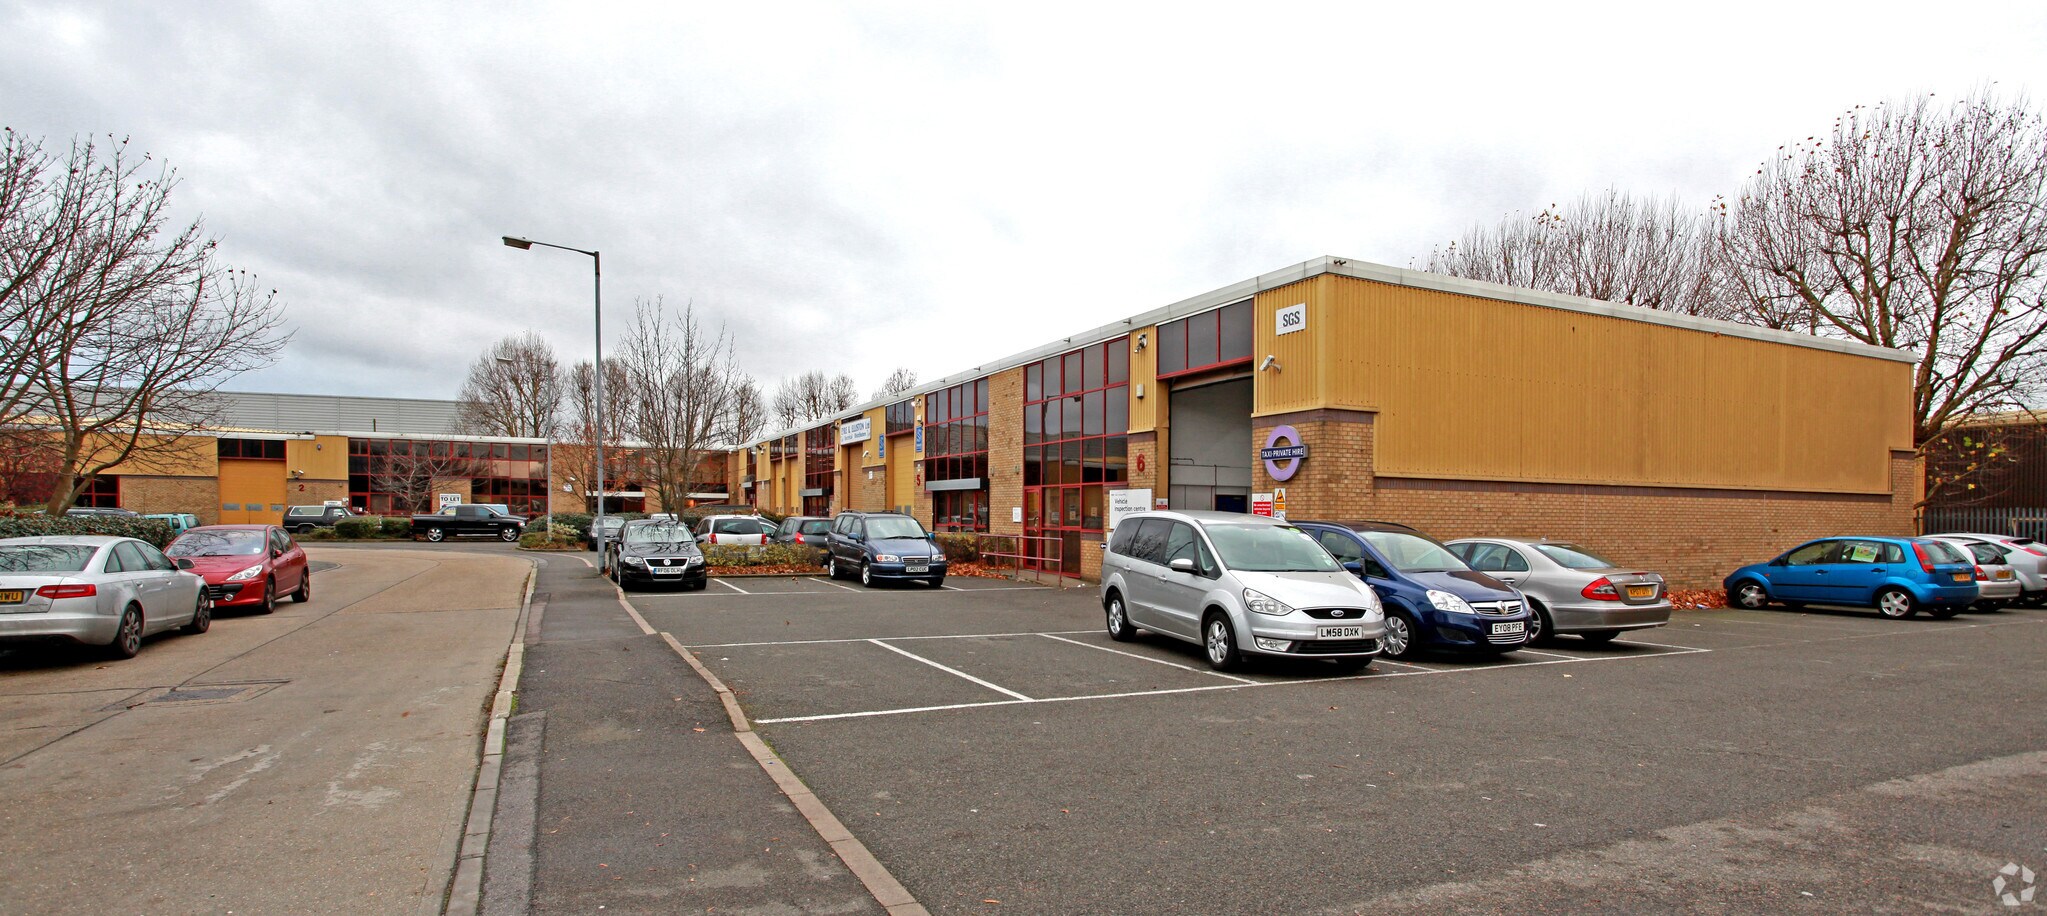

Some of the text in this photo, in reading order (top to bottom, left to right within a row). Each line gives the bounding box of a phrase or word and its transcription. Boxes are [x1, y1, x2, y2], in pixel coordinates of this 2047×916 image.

[1283, 311, 1300, 327] SGS
[1292, 448, 1304, 456] HIRE
[1136, 453, 1145, 473] 6
[916, 474, 921, 486] 5
[298, 484, 305, 492] 2
[1320, 627, 1359, 638] LM58 OXK
[1494, 622, 1522, 633] EY08 PFE
